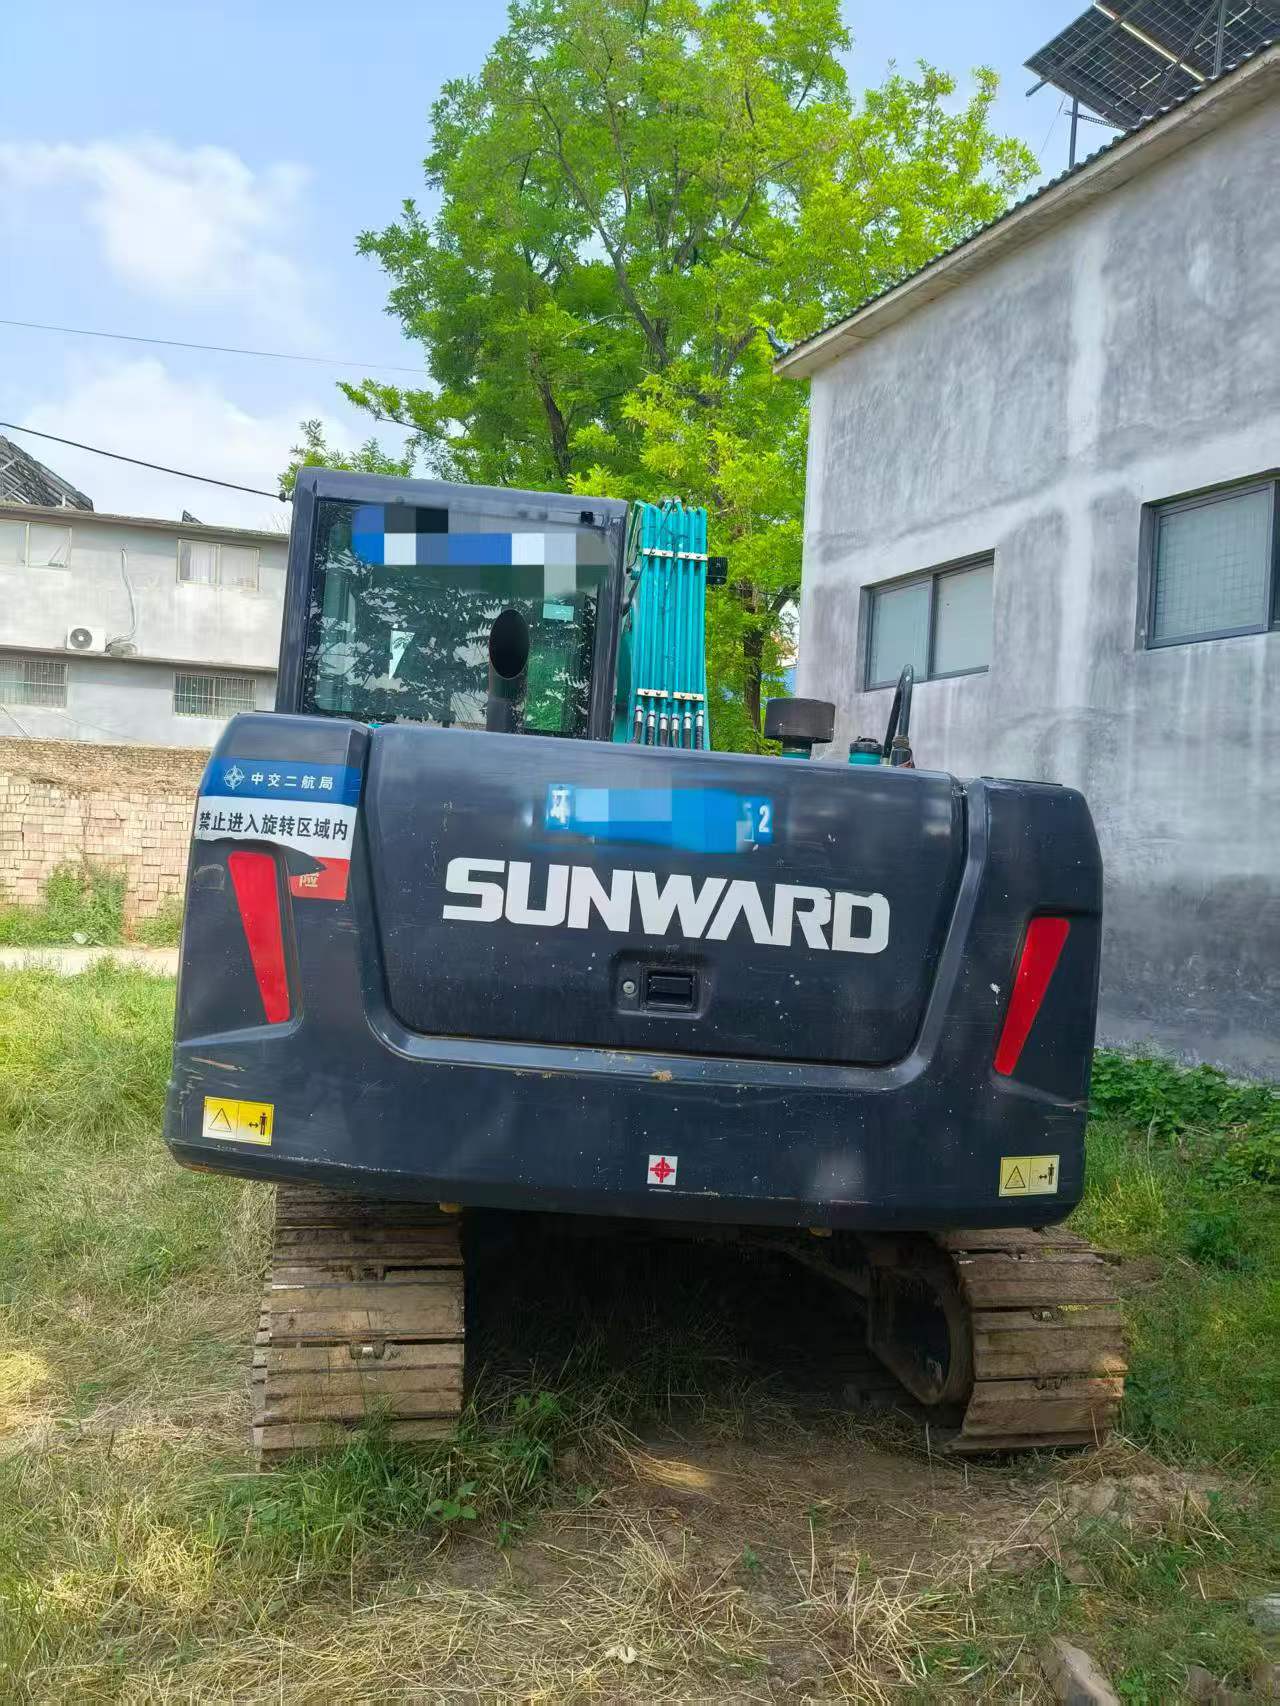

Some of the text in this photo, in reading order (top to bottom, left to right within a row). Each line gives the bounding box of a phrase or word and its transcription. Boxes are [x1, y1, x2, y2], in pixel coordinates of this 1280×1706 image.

[251, 772, 333, 790] 中交二航局
[198, 811, 348, 841] 禁止进入旋转区域内
[442, 857, 890, 954] SUNWARD
